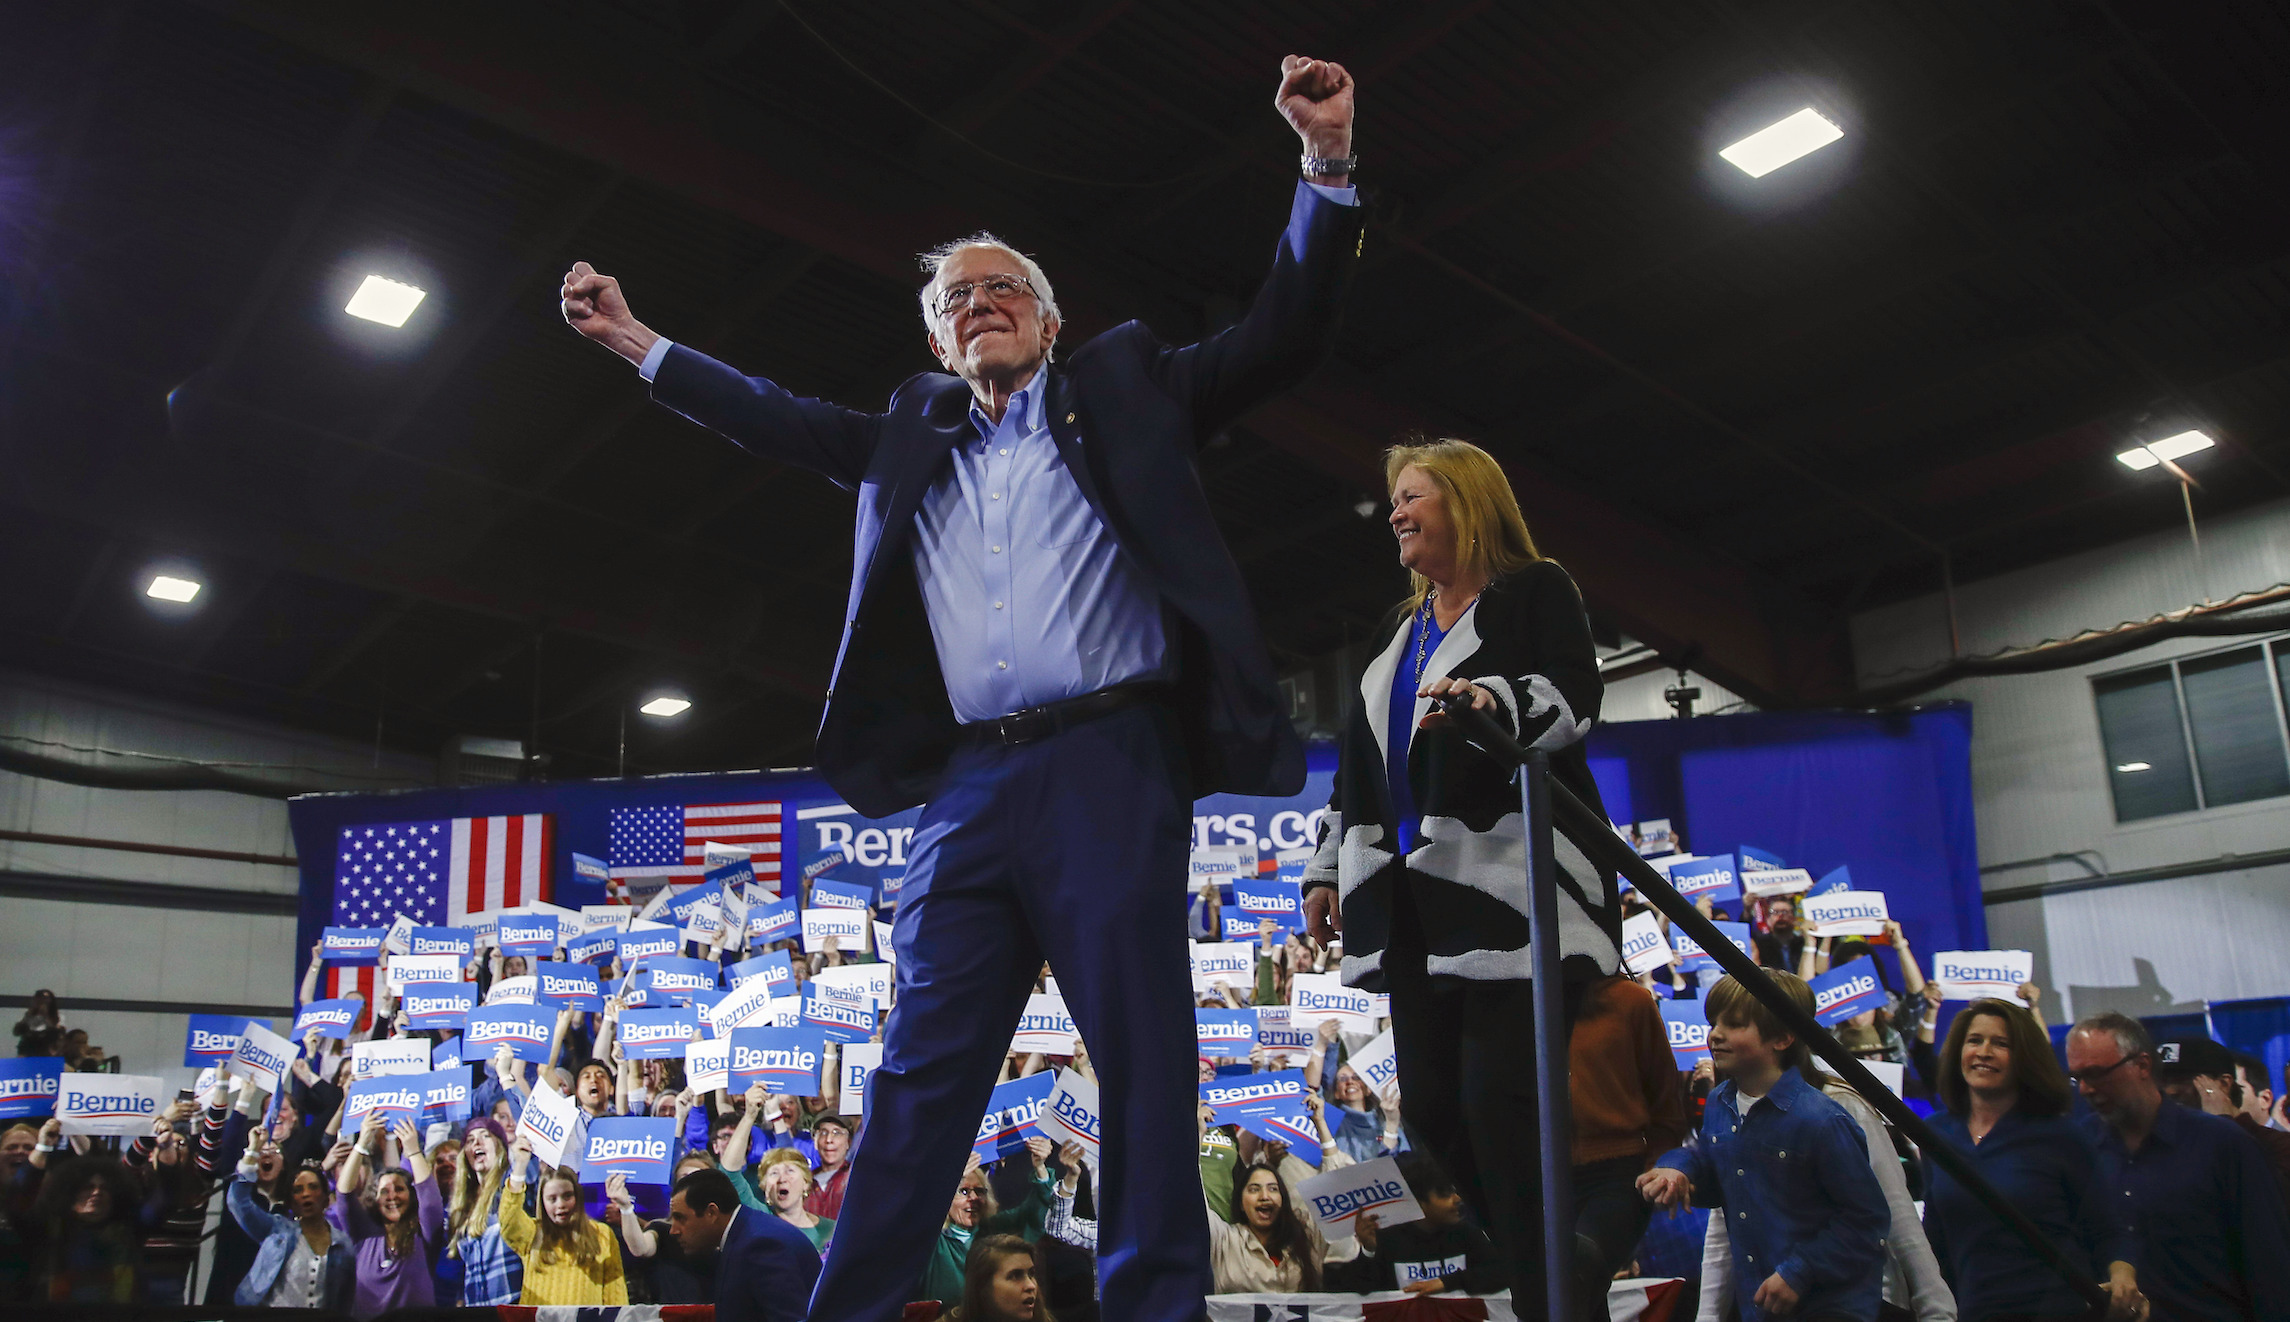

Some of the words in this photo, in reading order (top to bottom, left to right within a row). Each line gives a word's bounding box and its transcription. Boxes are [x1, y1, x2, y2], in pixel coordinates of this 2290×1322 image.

[816, 821, 914, 867] Ber
[575, 860, 609, 877] Bernie
[804, 850, 843, 875] Bernie
[1192, 861, 1237, 875] Bernie
[719, 869, 753, 889] ernie
[1675, 869, 1733, 892] Bernie
[1750, 872, 1806, 885] Bernie
[815, 888, 866, 910] Bernie
[1237, 891, 1297, 911] Bernie
[585, 912, 627, 927] Bernie
[694, 914, 719, 931] Ber
[752, 908, 796, 931] Bernie
[1811, 903, 1882, 921] Bernie
[501, 920, 555, 942] Bernie
[807, 920, 862, 937] Bernie
[324, 933, 381, 949] Bernie
[414, 936, 471, 955] Bernie
[570, 938, 616, 963] Bernie
[621, 938, 677, 959] Bernie
[393, 965, 454, 982] Bernie
[1201, 955, 1249, 972] ernie
[1944, 963, 2025, 985] Bernie
[543, 974, 599, 995] Bernie
[652, 969, 715, 991] Bernie
[406, 994, 473, 1014] Bernie
[825, 986, 863, 1003] Bernie
[1298, 989, 1371, 1014] Bernie
[1815, 975, 1876, 1011] ernie
[296, 1008, 352, 1029] Bernie
[714, 991, 766, 1036] Bernie
[805, 997, 874, 1031] Bernie
[1016, 1012, 1076, 1033] ernie
[1260, 1008, 1291, 1020] Bern
[467, 1018, 550, 1044] Bernie
[622, 1020, 694, 1041] Bernie
[1197, 1019, 1253, 1039] ernie
[1258, 1028, 1314, 1047] ernie
[1667, 1021, 1712, 1045] Ber
[239, 1038, 286, 1075] Bernie
[692, 1055, 729, 1074] Ber
[732, 1045, 816, 1071] Bernie
[0, 1073, 58, 1097] ernie
[1206, 1079, 1301, 1103] Bernie
[66, 1092, 155, 1114] Bernie
[348, 1088, 421, 1114] Bernie
[525, 1097, 564, 1145] Bernie
[977, 1096, 1047, 1135] ernie
[1053, 1089, 1100, 1138] Ber
[587, 1134, 667, 1161] Bernie
[1313, 1177, 1404, 1216] Bernie
